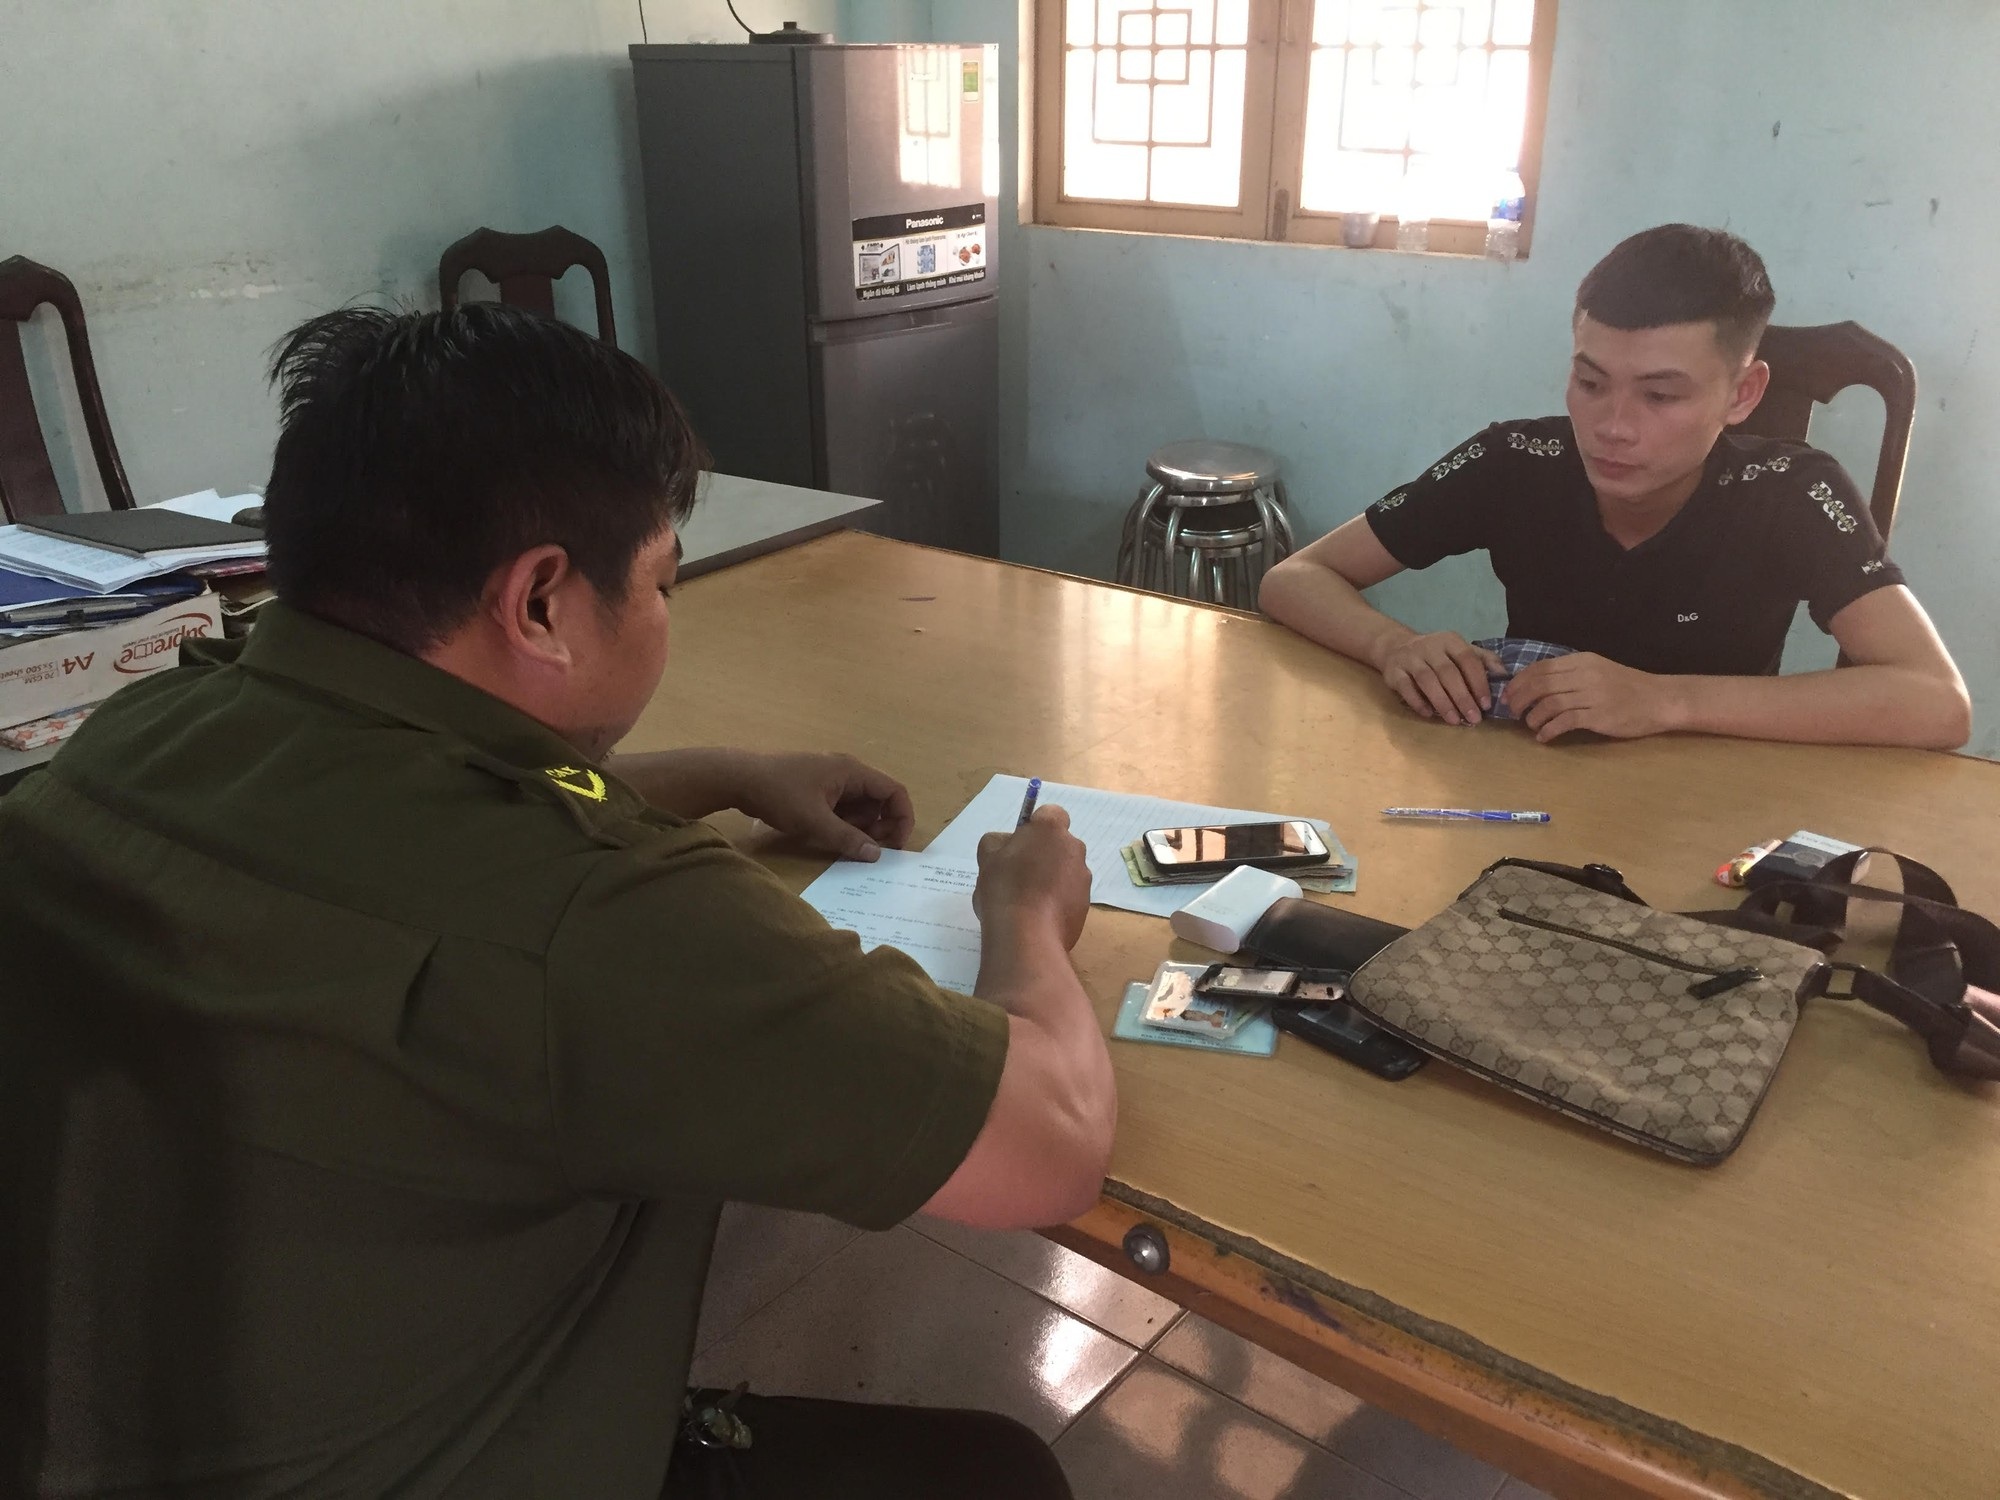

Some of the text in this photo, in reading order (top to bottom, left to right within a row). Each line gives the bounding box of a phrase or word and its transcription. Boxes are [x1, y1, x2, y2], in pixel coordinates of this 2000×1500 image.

[906, 215, 944, 229] Panasonic
[1677, 612, 1699, 623] D&G
[62, 652, 95, 675] A4
